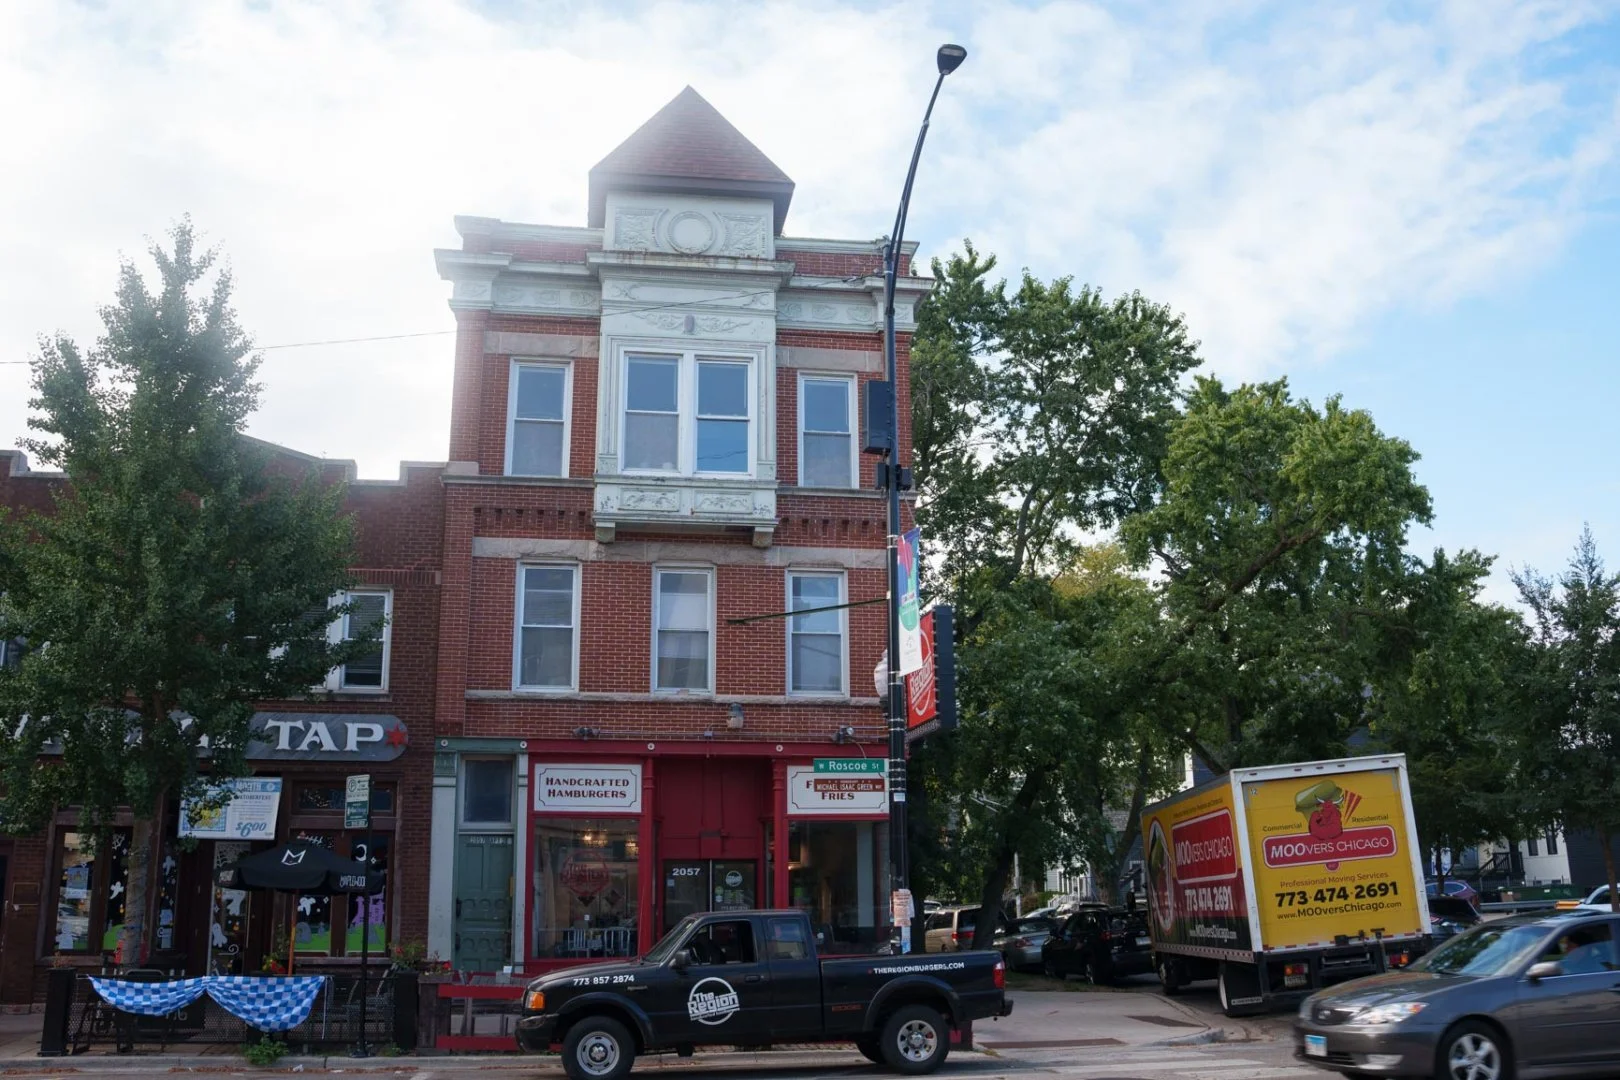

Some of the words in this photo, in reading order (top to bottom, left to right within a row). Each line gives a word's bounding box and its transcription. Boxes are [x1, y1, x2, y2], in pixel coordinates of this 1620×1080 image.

[263, 719, 385, 752] TAP
[829, 761, 868, 771] Roscoe
[545, 777, 630, 787] HANDCRAFTED
[816, 783, 839, 791] MICHAEL
[840, 783, 856, 791] ISAAC
[547, 789, 627, 798] HAMBURGERS
[821, 792, 855, 800] FRIES
[1351, 814, 1389, 823] Residential
[1262, 823, 1303, 832] Commercial
[1336, 837, 1389, 851] CHICAGO
[672, 867, 701, 876] 2057
[1280, 877, 1327, 888] Professional
[1328, 872, 1356, 884] Moving
[1357, 871, 1389, 881] Services
[873, 962, 965, 974] THEREGIONBURGERS.COM
[573, 978, 590, 986] 773
[593, 976, 610, 985] 857
[613, 975, 635, 984] 2874
[693, 992, 715, 1003] The
[687, 995, 739, 1015] Region
